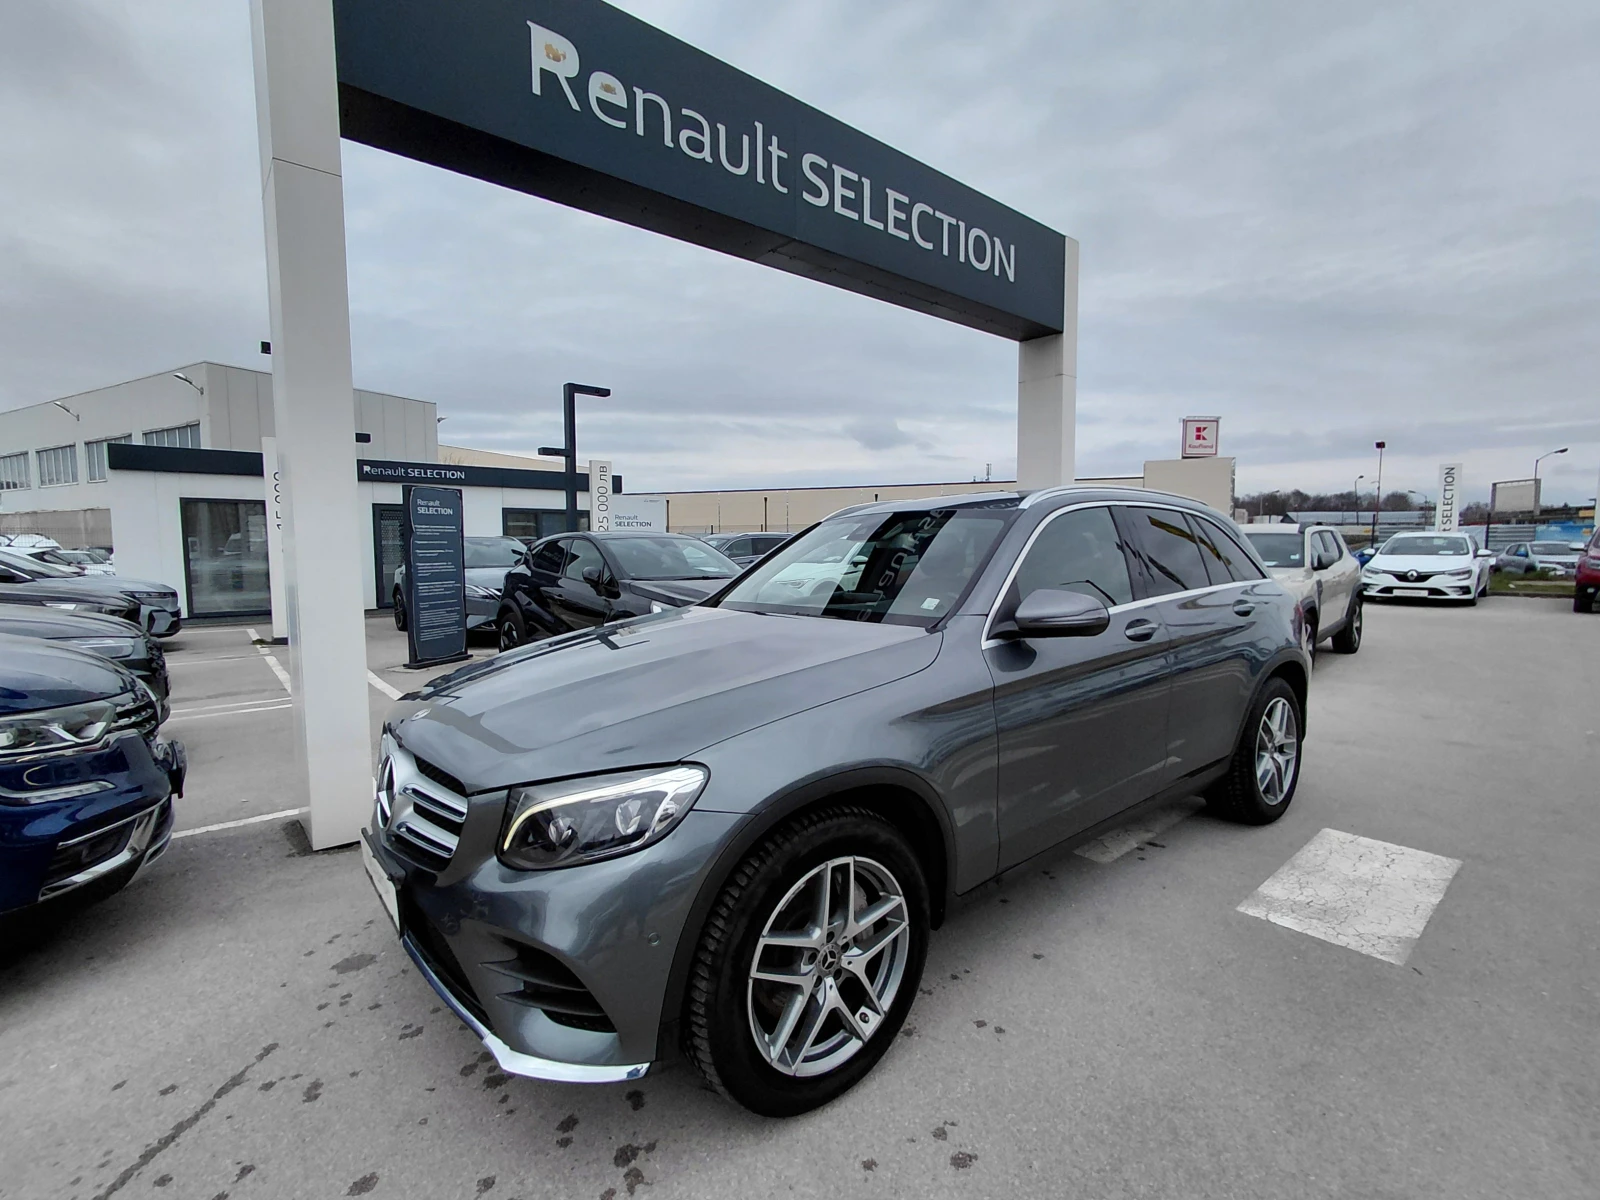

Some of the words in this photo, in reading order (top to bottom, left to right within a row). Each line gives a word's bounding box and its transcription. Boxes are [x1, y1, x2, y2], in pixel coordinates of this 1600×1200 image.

[526, 20, 788, 193] Renault
[801, 152, 1016, 282] SELECTION
[362, 465, 406, 477] Renault
[407, 468, 465, 480] SELECTION
[416, 498, 441, 507] Renault
[1441, 467, 1455, 525] SELECTION
[416, 506, 453, 516] SELECTION
